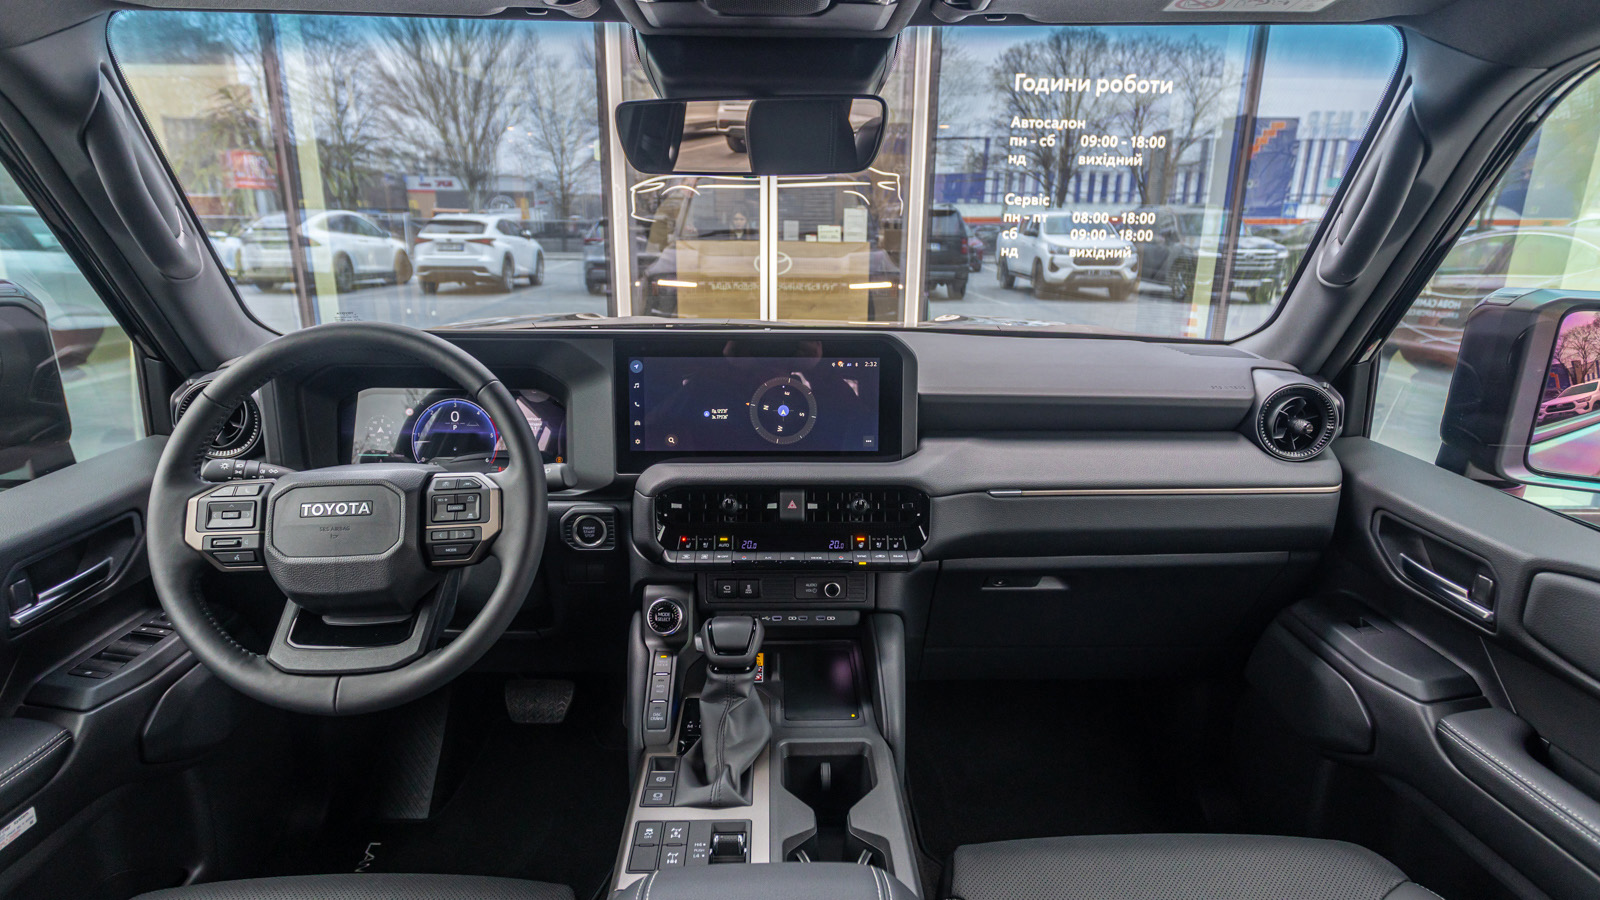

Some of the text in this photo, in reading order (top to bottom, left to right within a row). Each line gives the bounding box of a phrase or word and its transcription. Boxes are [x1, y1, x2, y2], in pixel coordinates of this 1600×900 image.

[1014, 73, 1174, 97] Години роботи
[1010, 116, 1086, 129] Автосалон
[1009, 136, 1027, 147] пн
[1039, 134, 1056, 147] сб
[1080, 135, 1118, 148] 09:00
[1131, 136, 1166, 149] 18:00
[1008, 153, 1143, 168] нд вихідний
[1004, 193, 1050, 208] Сервіс
[1003, 212, 1021, 223] пн
[1032, 212, 1049, 223] пт
[1072, 212, 1109, 224] 08:00
[1121, 212, 1156, 225] 18:00
[1002, 227, 1018, 240] сб
[1070, 229, 1107, 241] 09:00
[1118, 229, 1154, 242] 18:00
[1000, 246, 1132, 260] нд вихідний
[450, 411, 460, 422] 0
[301, 502, 371, 517] TOYOTA
[741, 540, 757, 549] 20.0
[828, 540, 844, 549] 20.0
